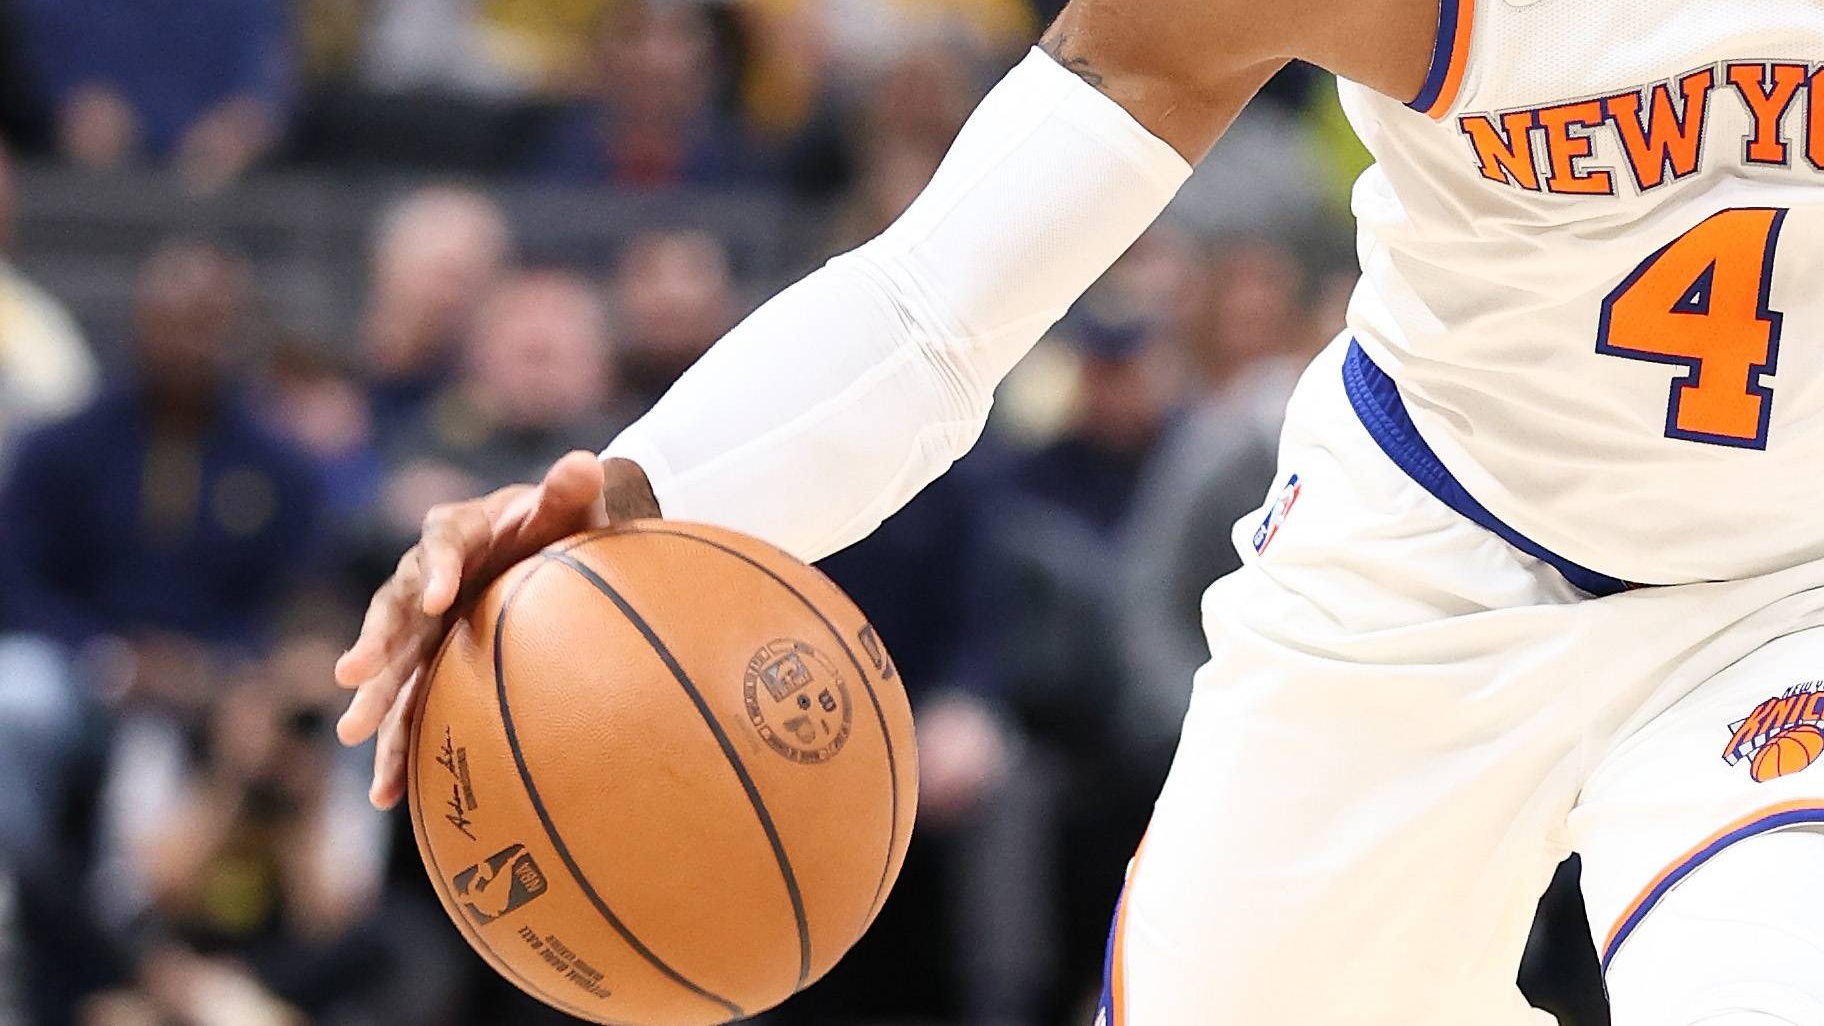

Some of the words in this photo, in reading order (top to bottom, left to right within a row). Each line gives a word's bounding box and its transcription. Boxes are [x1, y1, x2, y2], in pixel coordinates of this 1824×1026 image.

[1458, 63, 1717, 198] NEW
[1595, 208, 1789, 451] 4
[1782, 681, 1812, 698] NEW
